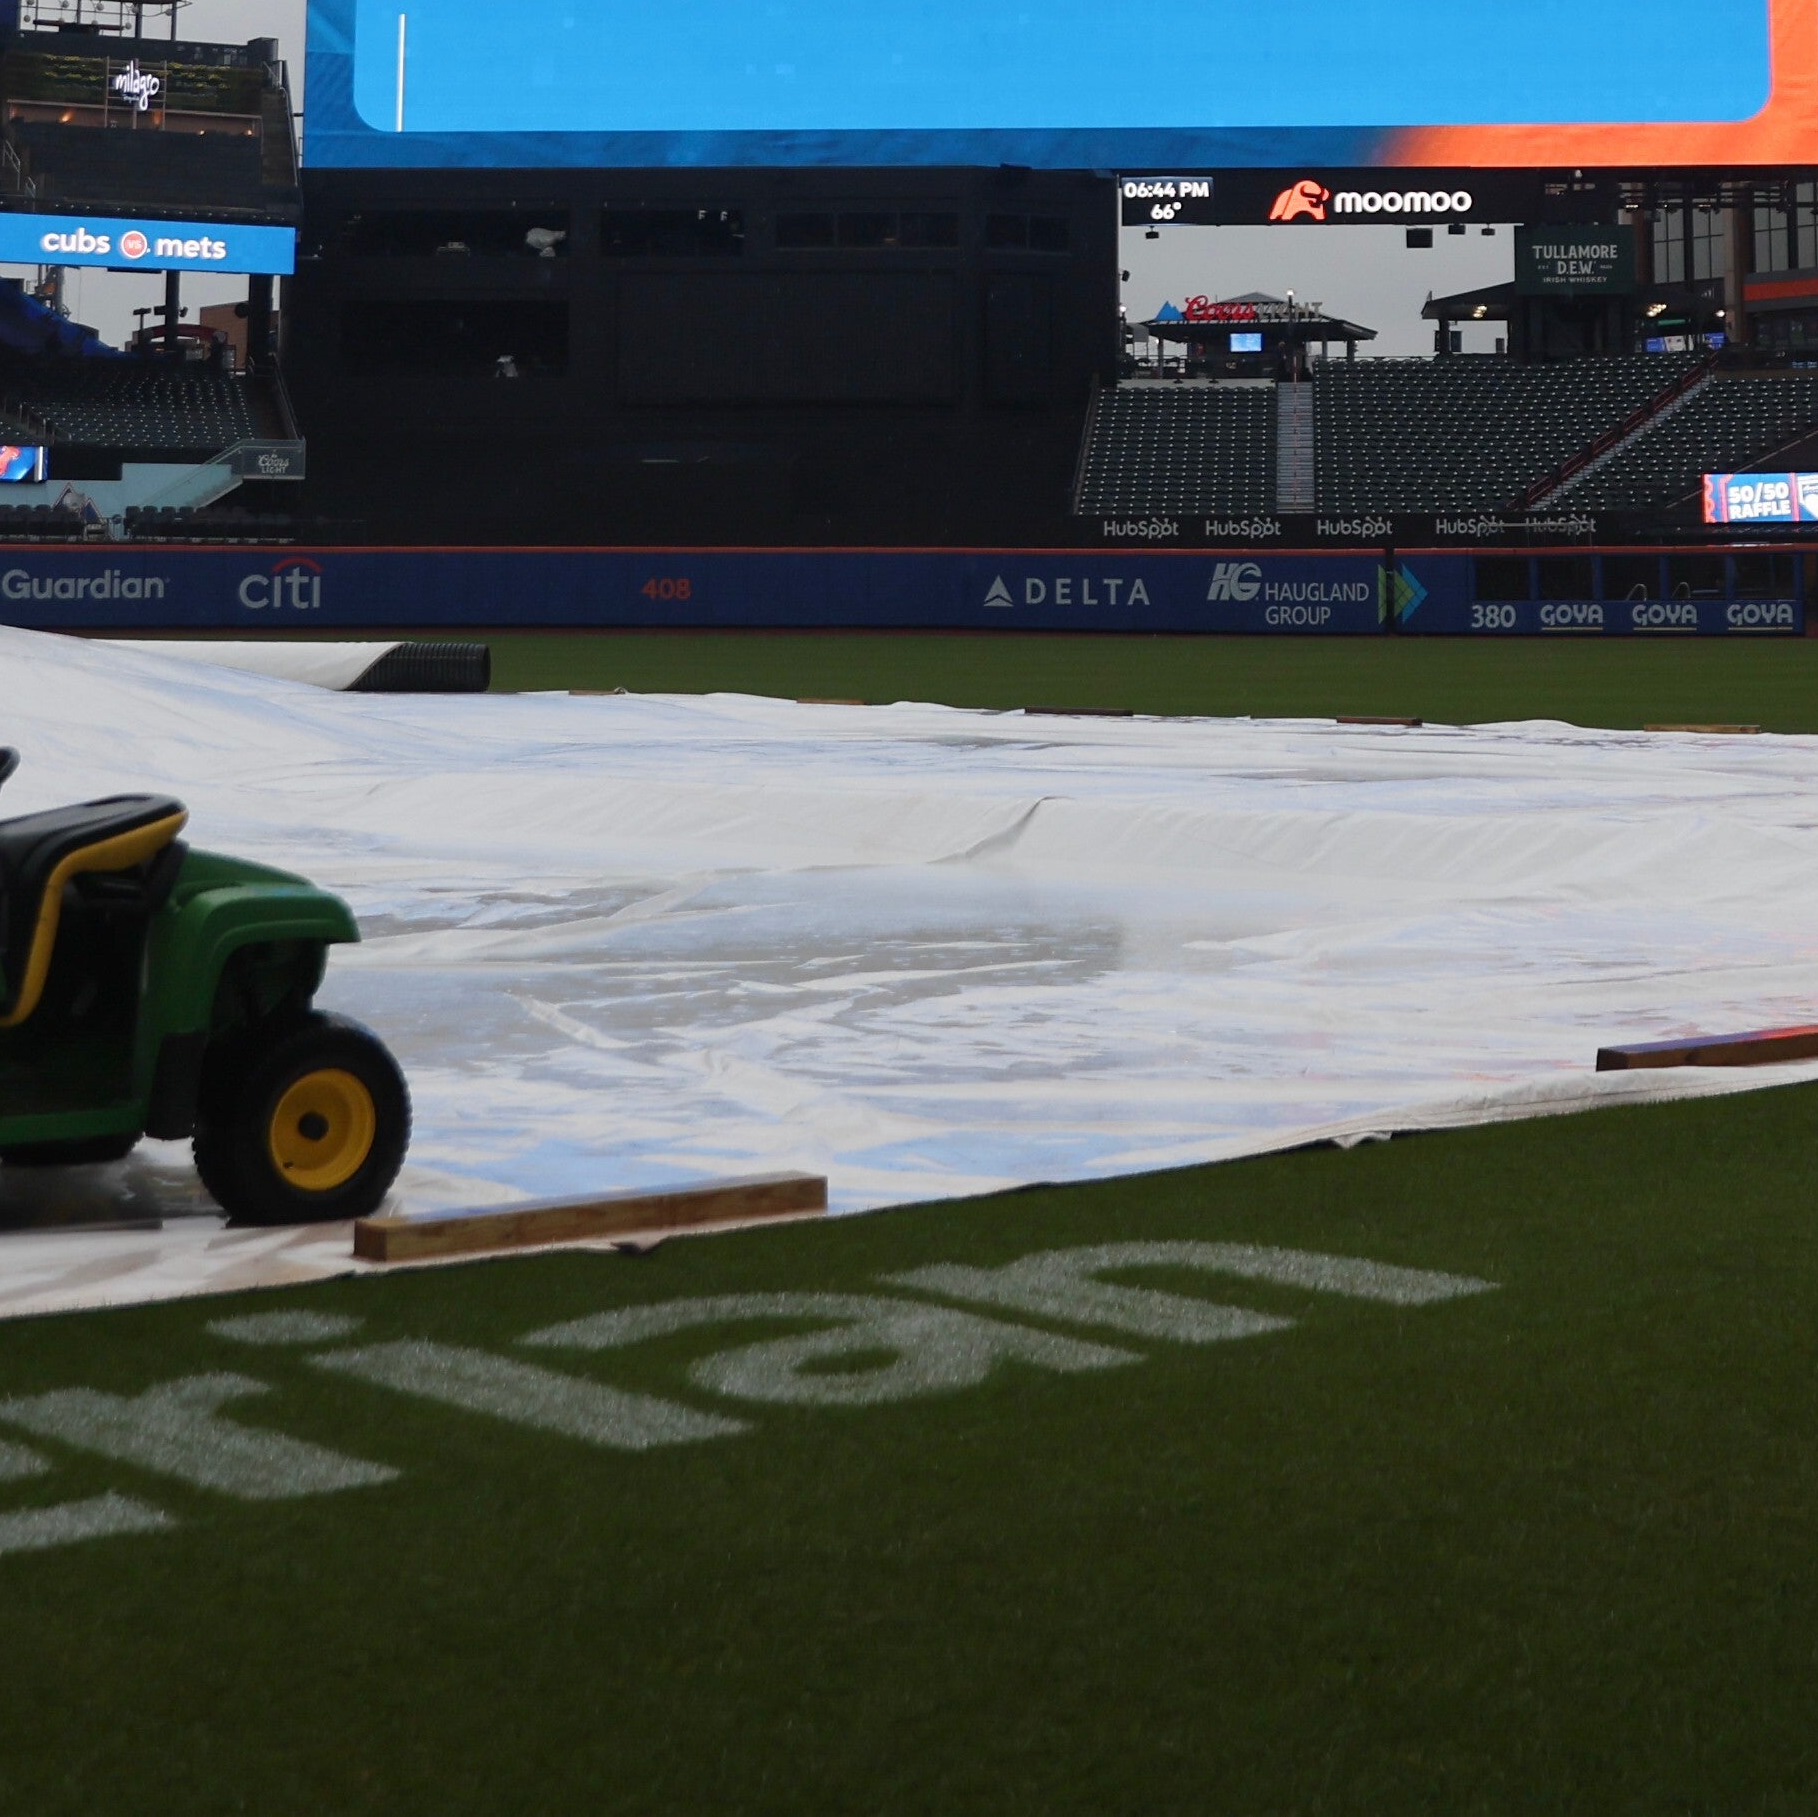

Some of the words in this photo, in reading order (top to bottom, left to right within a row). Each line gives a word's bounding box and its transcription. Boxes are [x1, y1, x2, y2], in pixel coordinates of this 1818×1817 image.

[1124, 182, 1174, 198] 06:44
[1179, 182, 1209, 197] PM
[1335, 190, 1472, 213] moomoo
[42, 228, 109, 254] cubs
[157, 234, 225, 260] mets
[1533, 243, 1618, 259] TULLAMORE
[1184, 295, 1255, 321] Coors
[1728, 482, 1788, 503] 50/50
[1730, 500, 1791, 519] RAFFLE
[1104, 517, 1179, 539] HubSpot
[1205, 517, 1281, 539] HubSpot
[1317, 517, 1393, 539] HubSpot
[2, 568, 164, 600] Guardian
[239, 572, 321, 609] citi
[642, 578, 691, 600] 408
[1025, 578, 1150, 605] DELTA
[1265, 583, 1369, 602] HAUGLAND
[1265, 605, 1330, 626] GROUP
[1472, 604, 1516, 628] 380
[1540, 604, 1603, 626] GOYA
[1632, 604, 1697, 626] GOYA
[1727, 602, 1793, 625] GOYA
